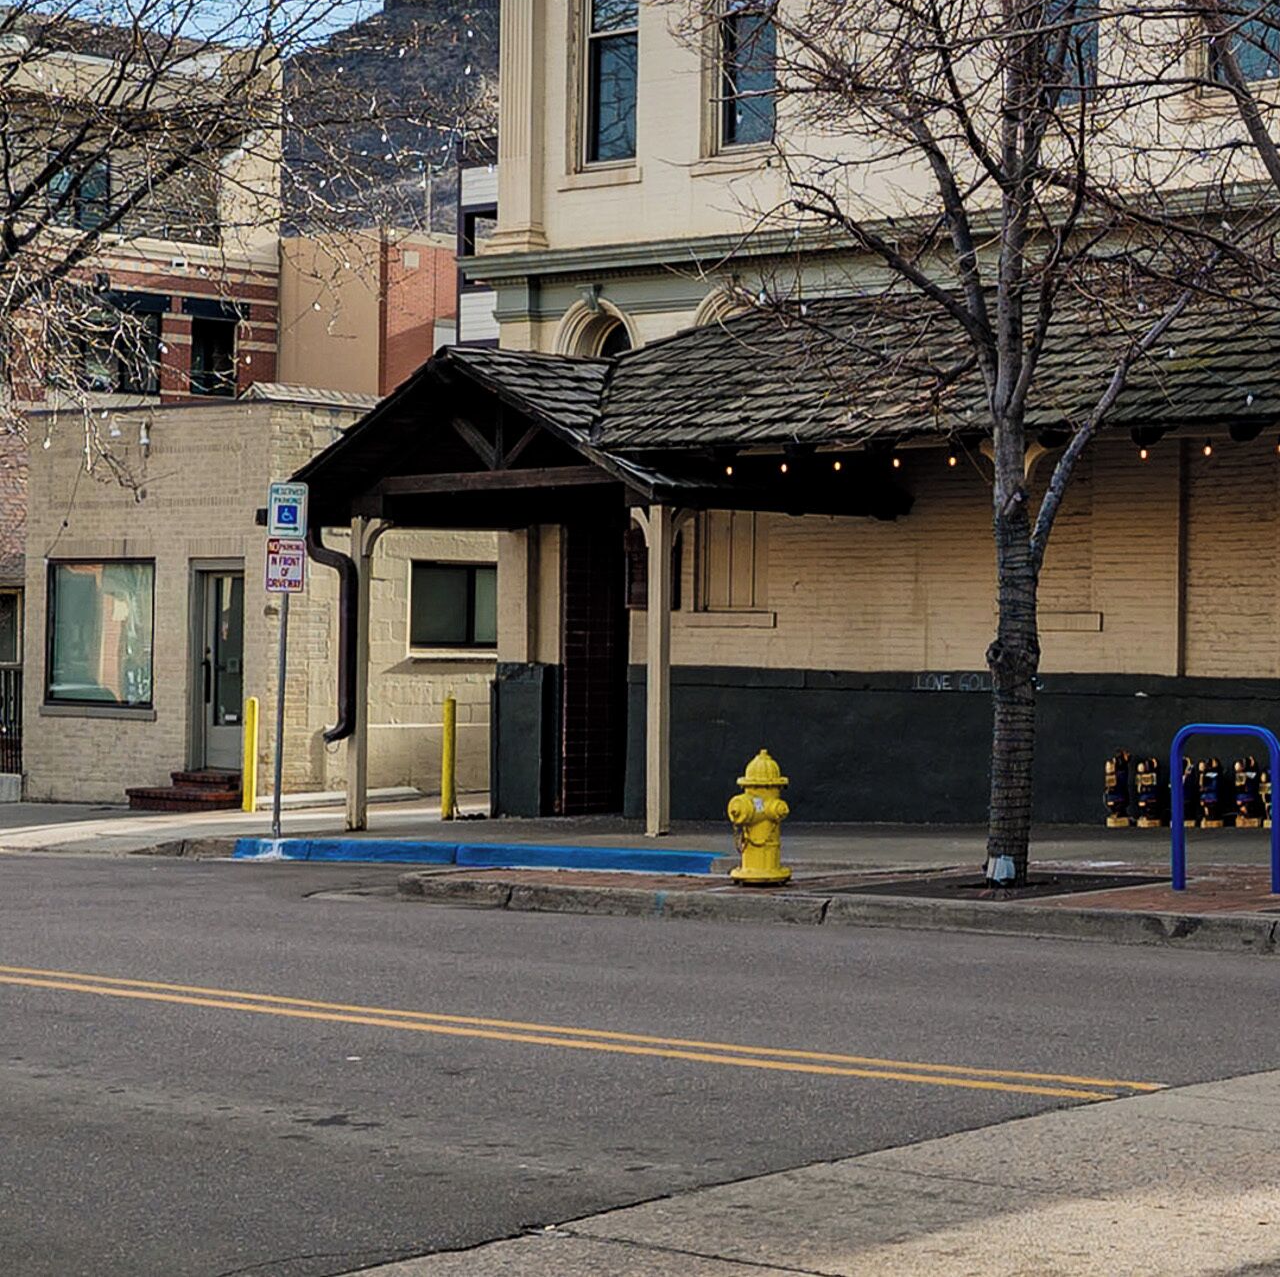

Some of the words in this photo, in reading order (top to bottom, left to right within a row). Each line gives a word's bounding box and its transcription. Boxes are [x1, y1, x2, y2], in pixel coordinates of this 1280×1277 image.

[272, 487, 307, 496] RESERVED
[274, 497, 303, 505] PARKING
[268, 542, 279, 552] NO
[279, 556, 301, 566] FRONT
[280, 567, 290, 577] OF
[266, 578, 302, 589] DRIVEWAY
